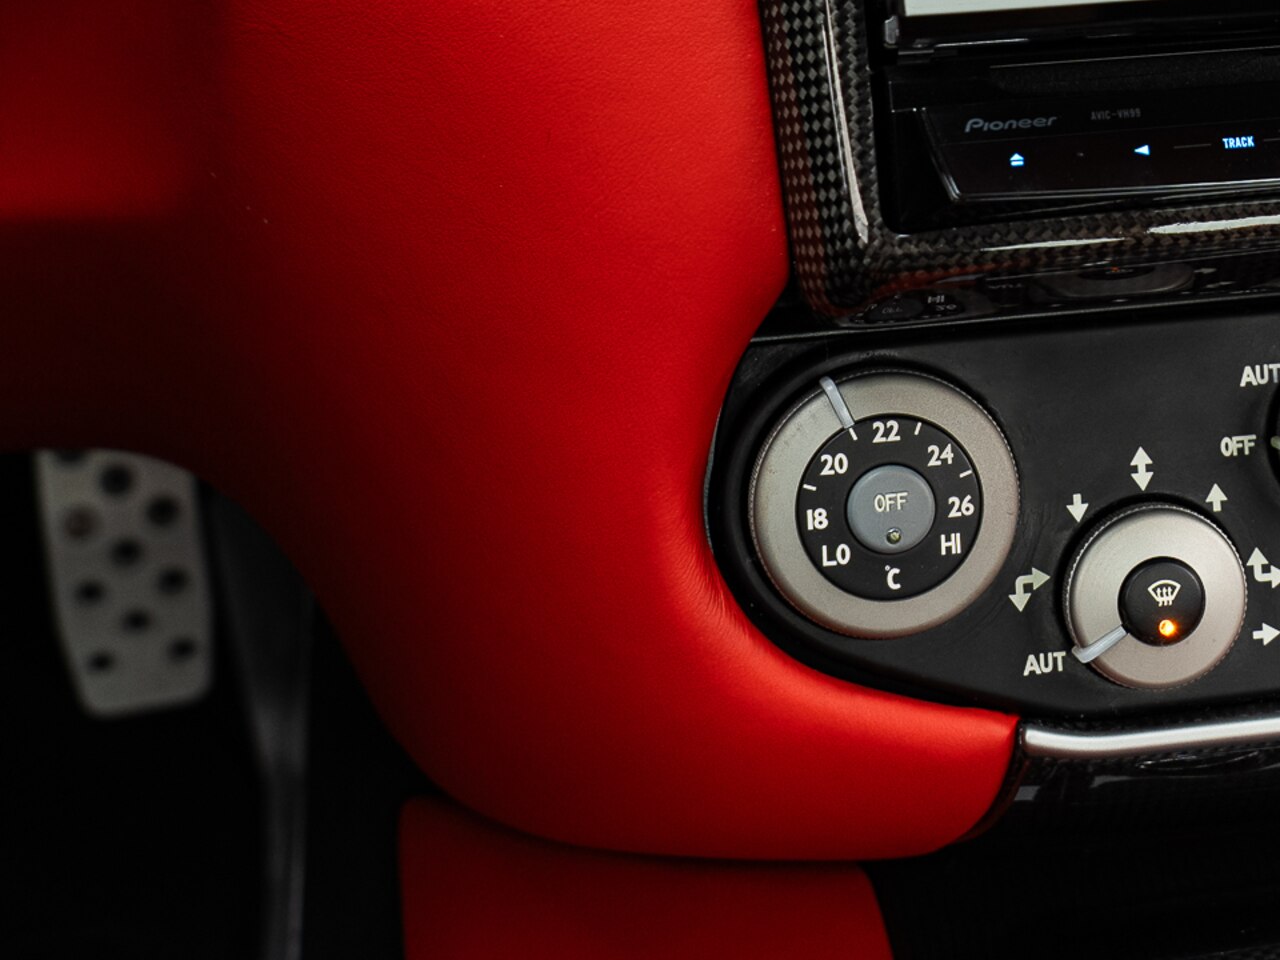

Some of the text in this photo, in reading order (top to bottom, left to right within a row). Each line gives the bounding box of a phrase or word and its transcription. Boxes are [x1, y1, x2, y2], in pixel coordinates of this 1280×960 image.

[964, 116, 1058, 134] Pioneer
[1222, 135, 1256, 150] TRACK
[871, 419, 901, 444] 22
[926, 442, 955, 468] 24
[1219, 433, 1258, 458] OFF
[819, 452, 849, 477] 20
[873, 491, 909, 514] OFF
[947, 494, 976, 519] 26
[805, 507, 830, 531] 18
[821, 542, 851, 568] LO
[940, 532, 963, 556] HI
[1022, 650, 1067, 678] AUT
